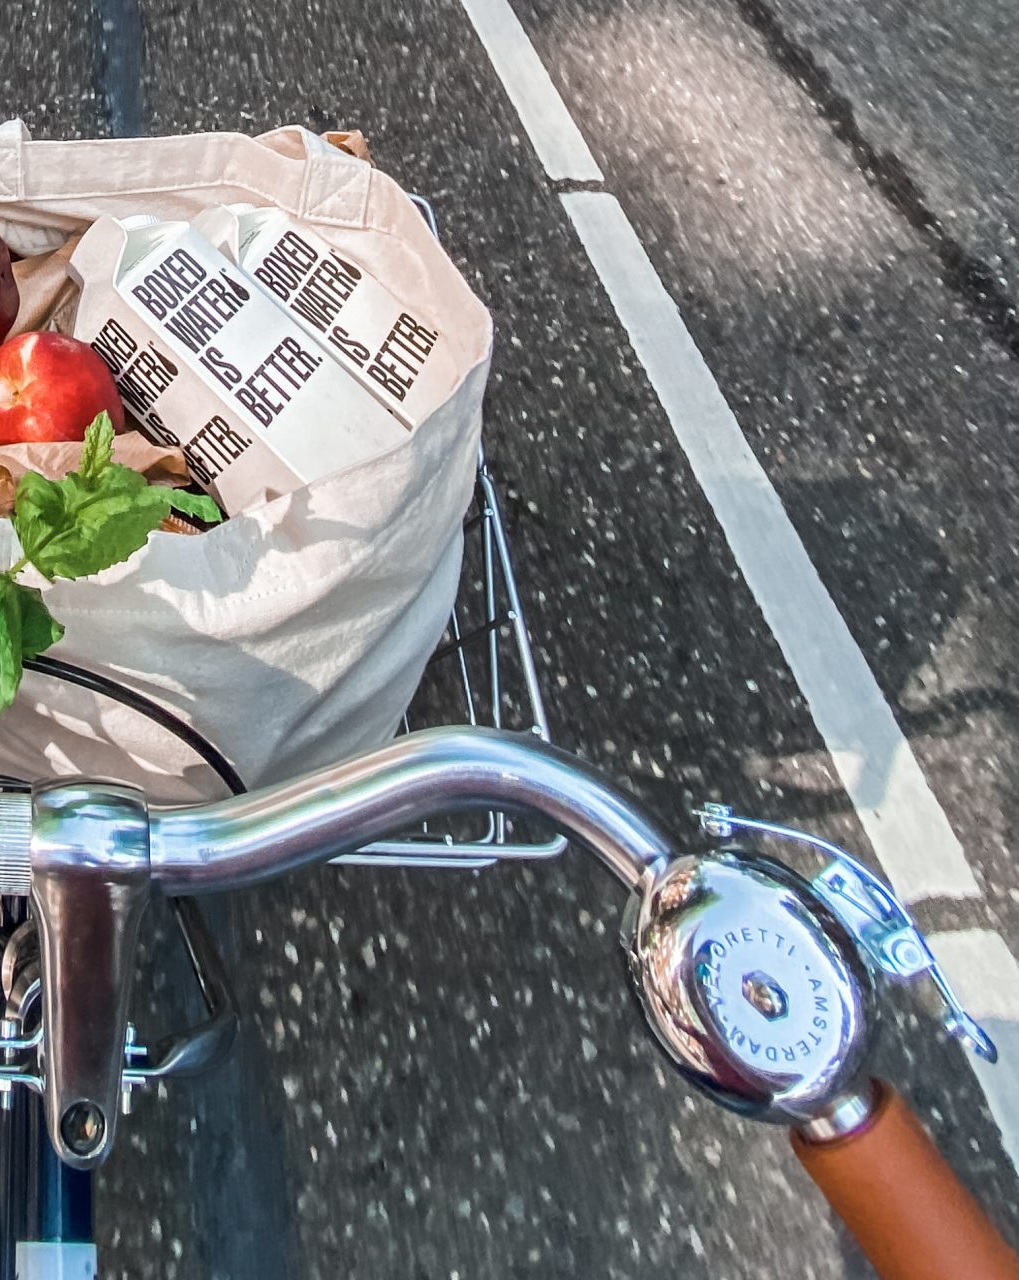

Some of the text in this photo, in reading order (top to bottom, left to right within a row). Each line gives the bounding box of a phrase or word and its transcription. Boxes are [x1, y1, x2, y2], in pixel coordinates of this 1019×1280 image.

[131, 248, 208, 322] BOXED
[253, 230, 319, 303] BOXED
[290, 261, 354, 333] WATER
[90, 317, 138, 374] OXED
[163, 277, 245, 349] WATER
[328, 325, 371, 367] IS
[117, 349, 174, 417] WATER
[198, 346, 243, 391] IS
[234, 335, 323, 429] BETTER.
[366, 312, 439, 403] BETTER.
[145, 412, 181, 448] IS
[182, 414, 253, 486] BETTER.
[729, 978, 830, 1063] AMSTERDAM
